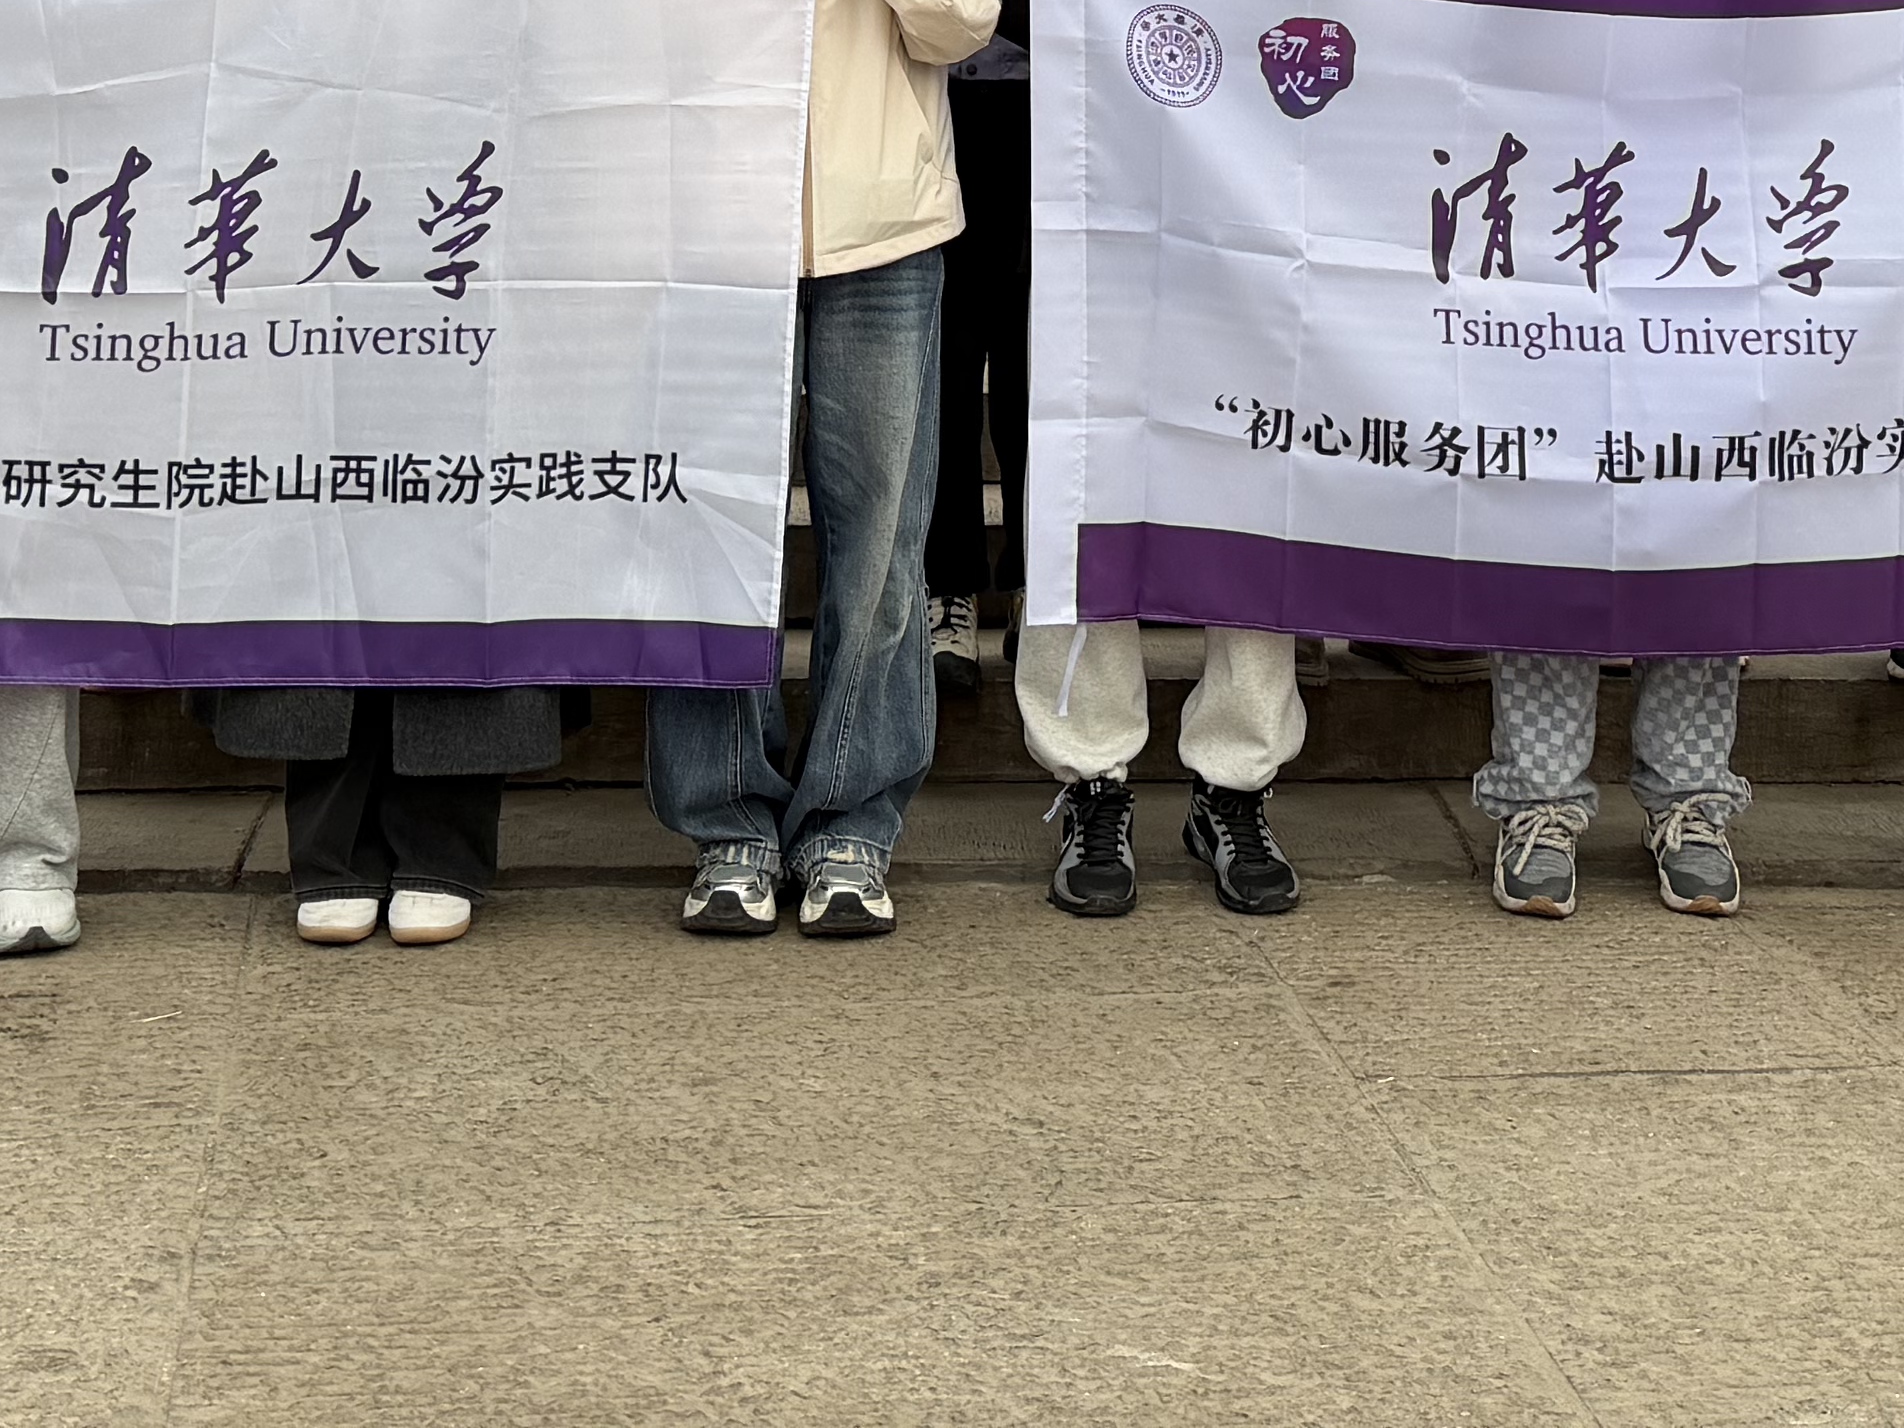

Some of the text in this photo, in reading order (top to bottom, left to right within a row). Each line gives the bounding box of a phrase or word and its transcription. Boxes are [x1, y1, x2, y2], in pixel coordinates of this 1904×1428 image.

[1263, 29, 1321, 106] 初心
[38, 315, 497, 374] Tsinghua University
[1432, 308, 1859, 366] Tsinghua University
